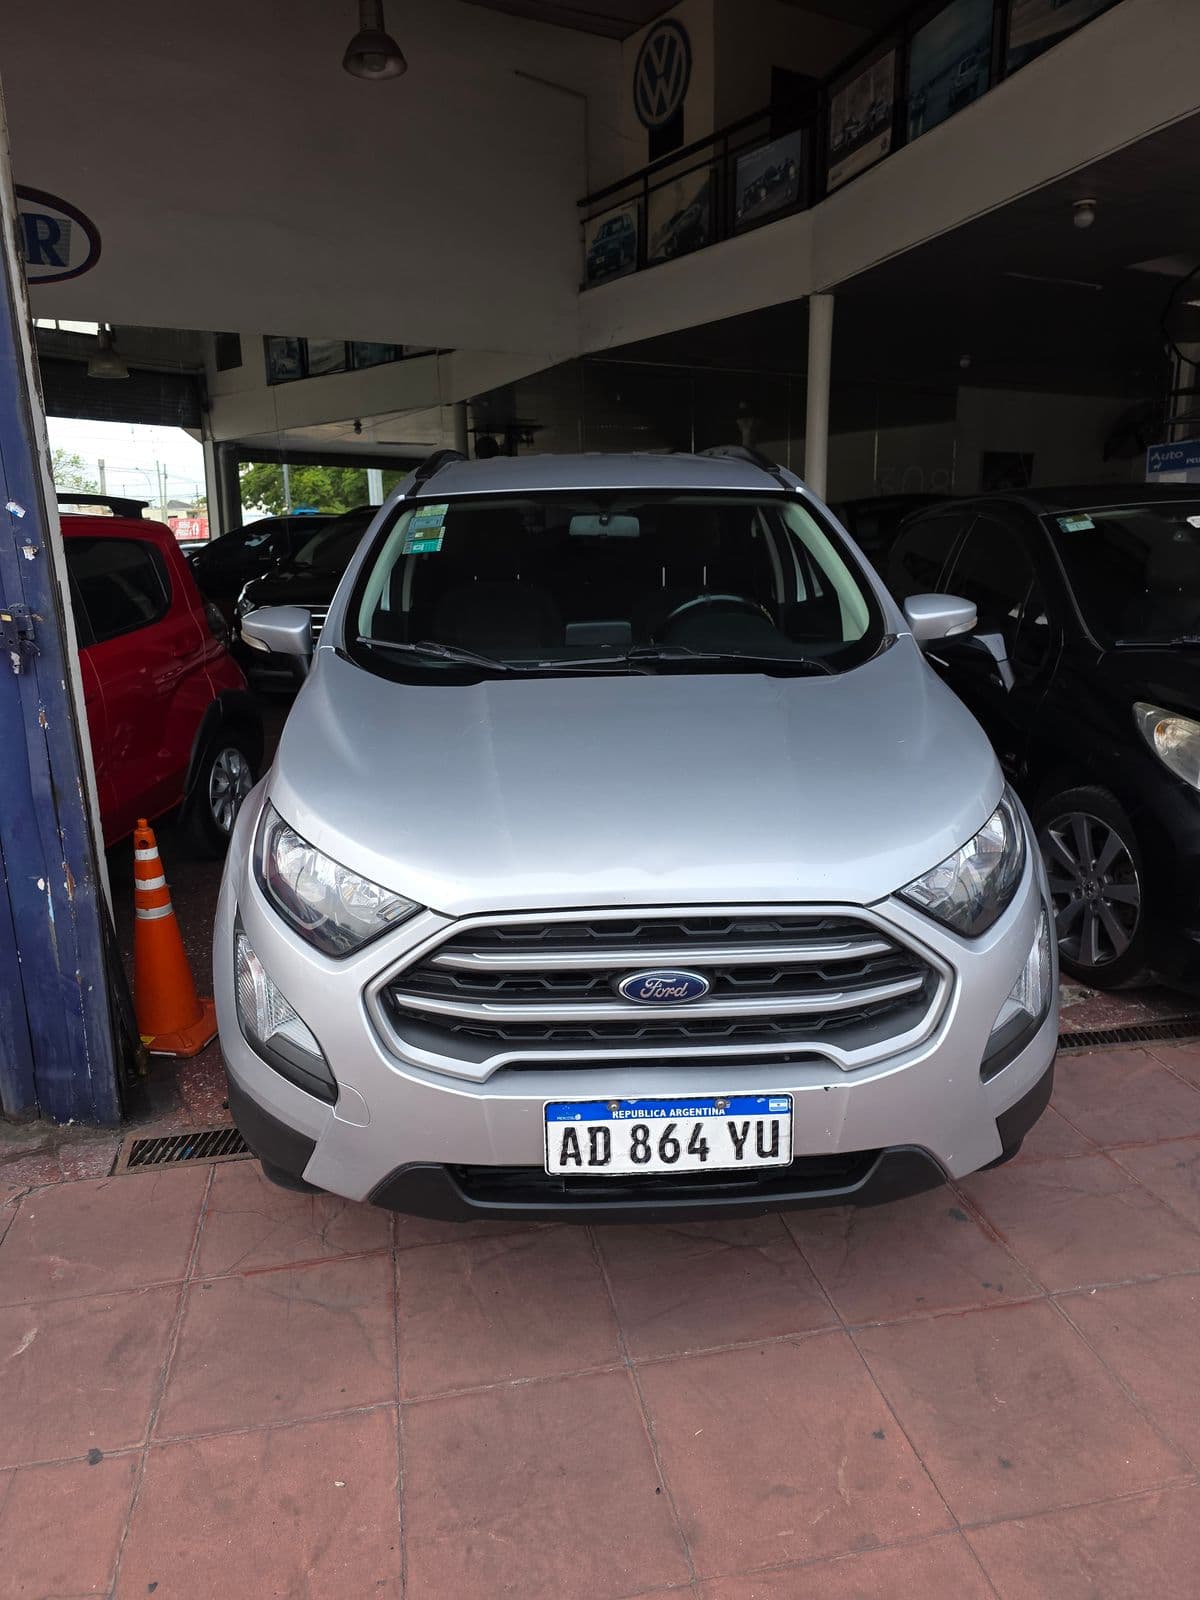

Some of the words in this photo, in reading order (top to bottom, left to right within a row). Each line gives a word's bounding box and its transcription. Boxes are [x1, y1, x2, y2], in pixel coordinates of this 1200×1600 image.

[640, 977, 689, 998] Ford
[612, 1109, 667, 1119] REPUBLICA
[669, 1106, 726, 1117] ARGENTINA
[559, 1125, 611, 1166] AD
[630, 1122, 711, 1164] 864
[727, 1119, 780, 1160] YU
